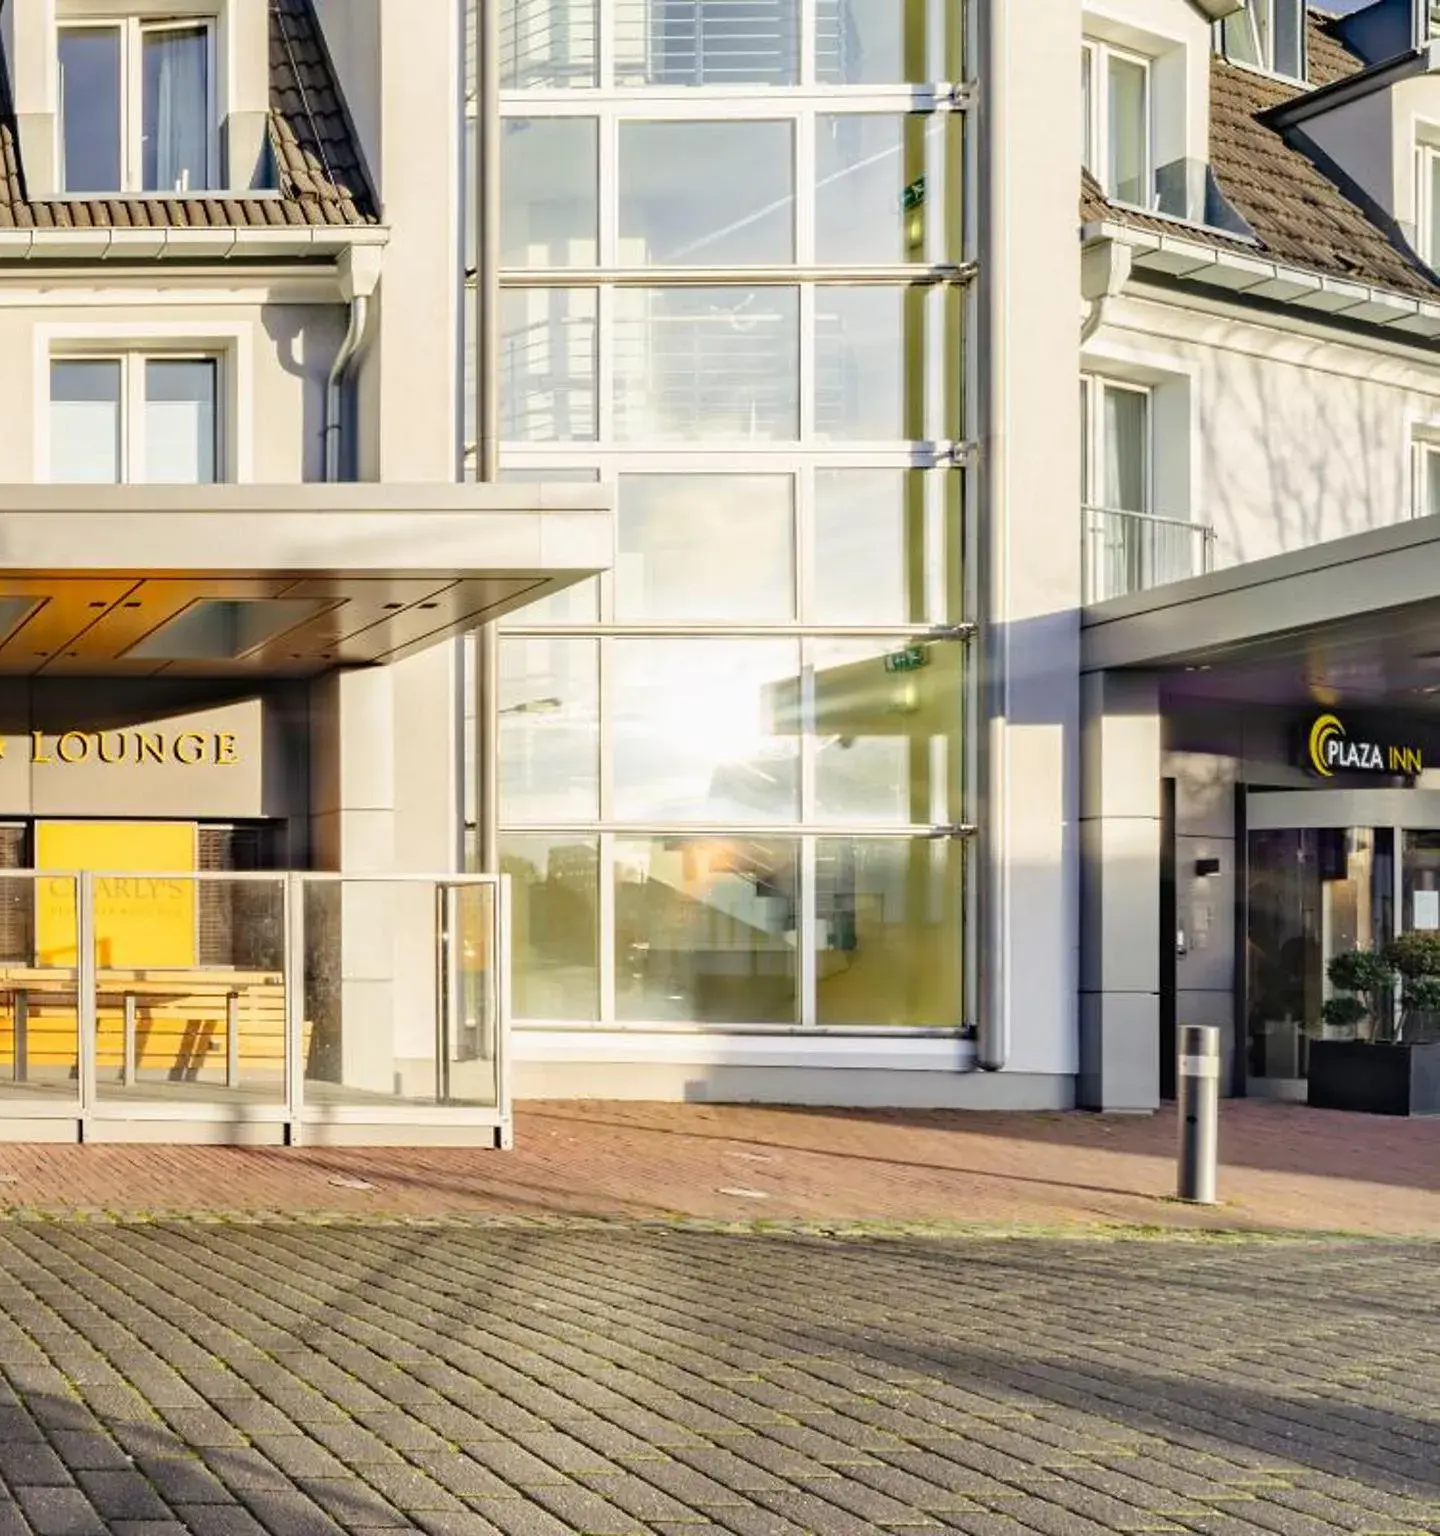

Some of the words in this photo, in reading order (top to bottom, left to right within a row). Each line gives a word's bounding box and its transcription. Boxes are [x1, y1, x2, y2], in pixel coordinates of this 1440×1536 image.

[31, 730, 240, 764] LOUNGE
[1328, 740, 1384, 769] PLAZA
[1389, 746, 1422, 773] INN
[49, 877, 184, 899] CARLY'S
